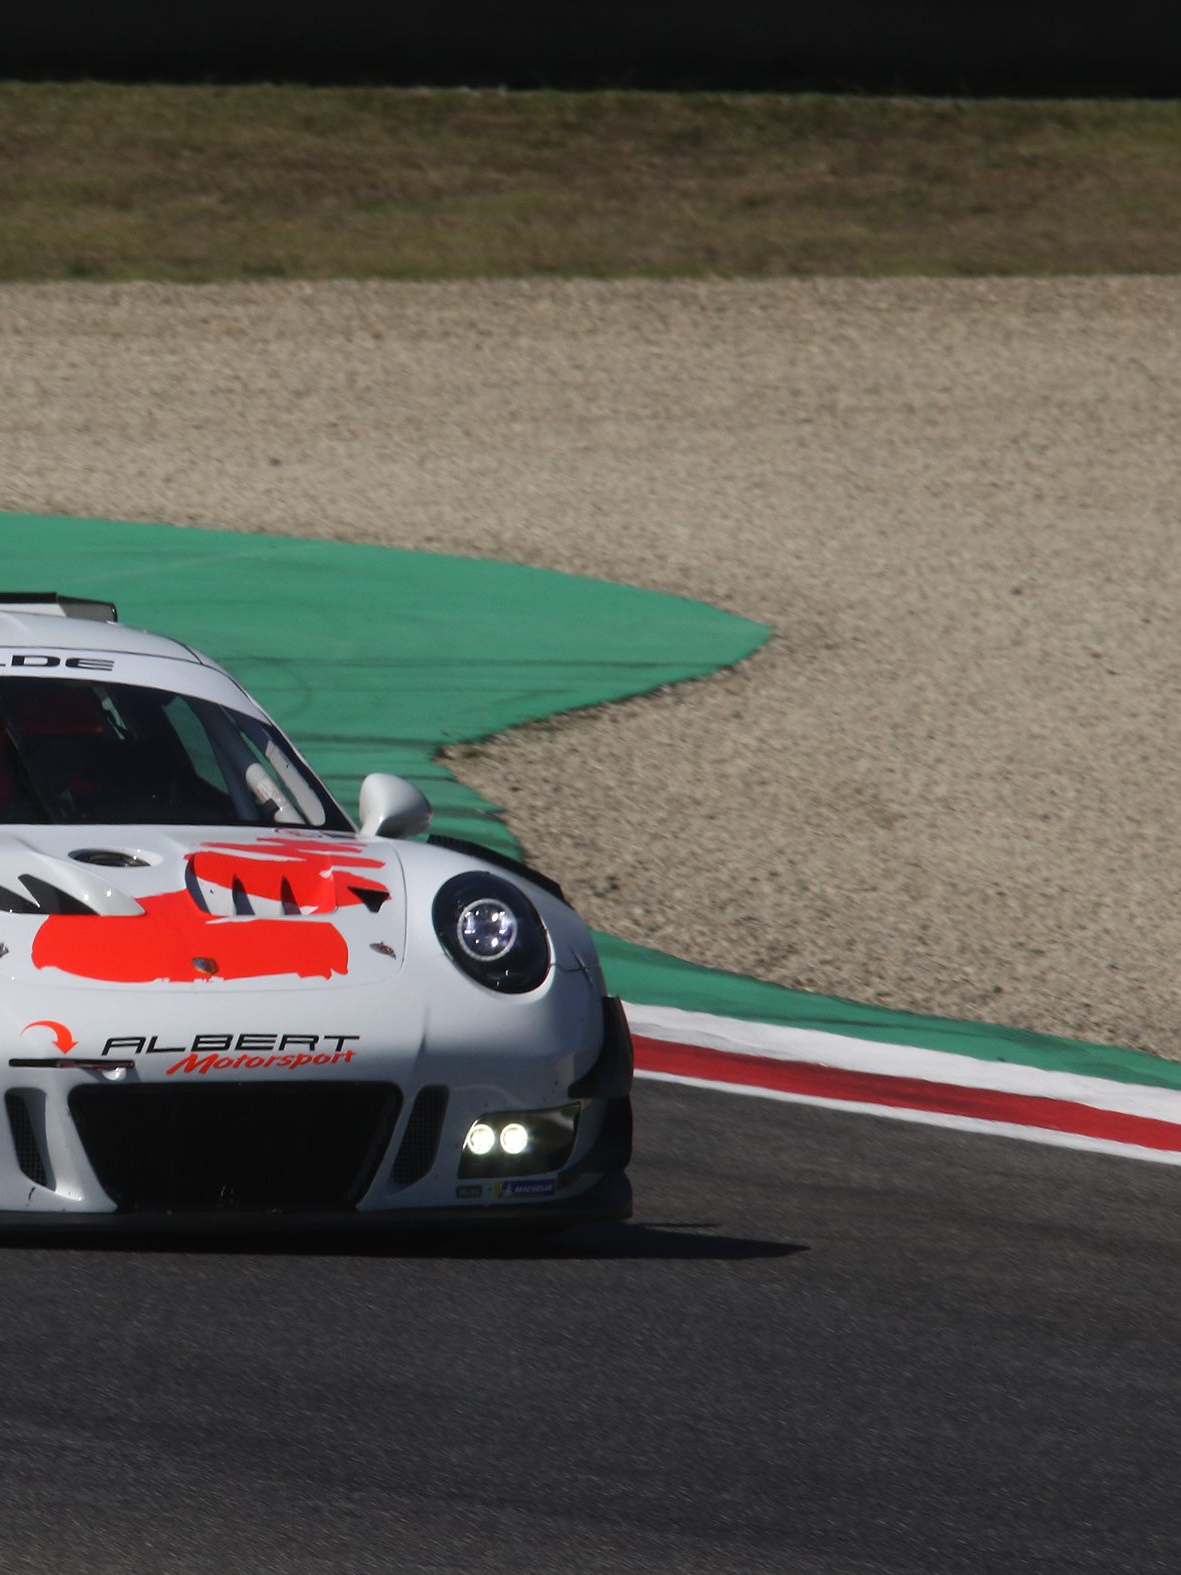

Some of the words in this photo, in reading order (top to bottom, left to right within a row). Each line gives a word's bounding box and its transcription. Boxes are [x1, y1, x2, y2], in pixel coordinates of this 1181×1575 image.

[101, 1034, 361, 1056] ALBERT
[166, 1050, 357, 1075] Motorsport
[515, 1184, 554, 1194] MICHELIN
